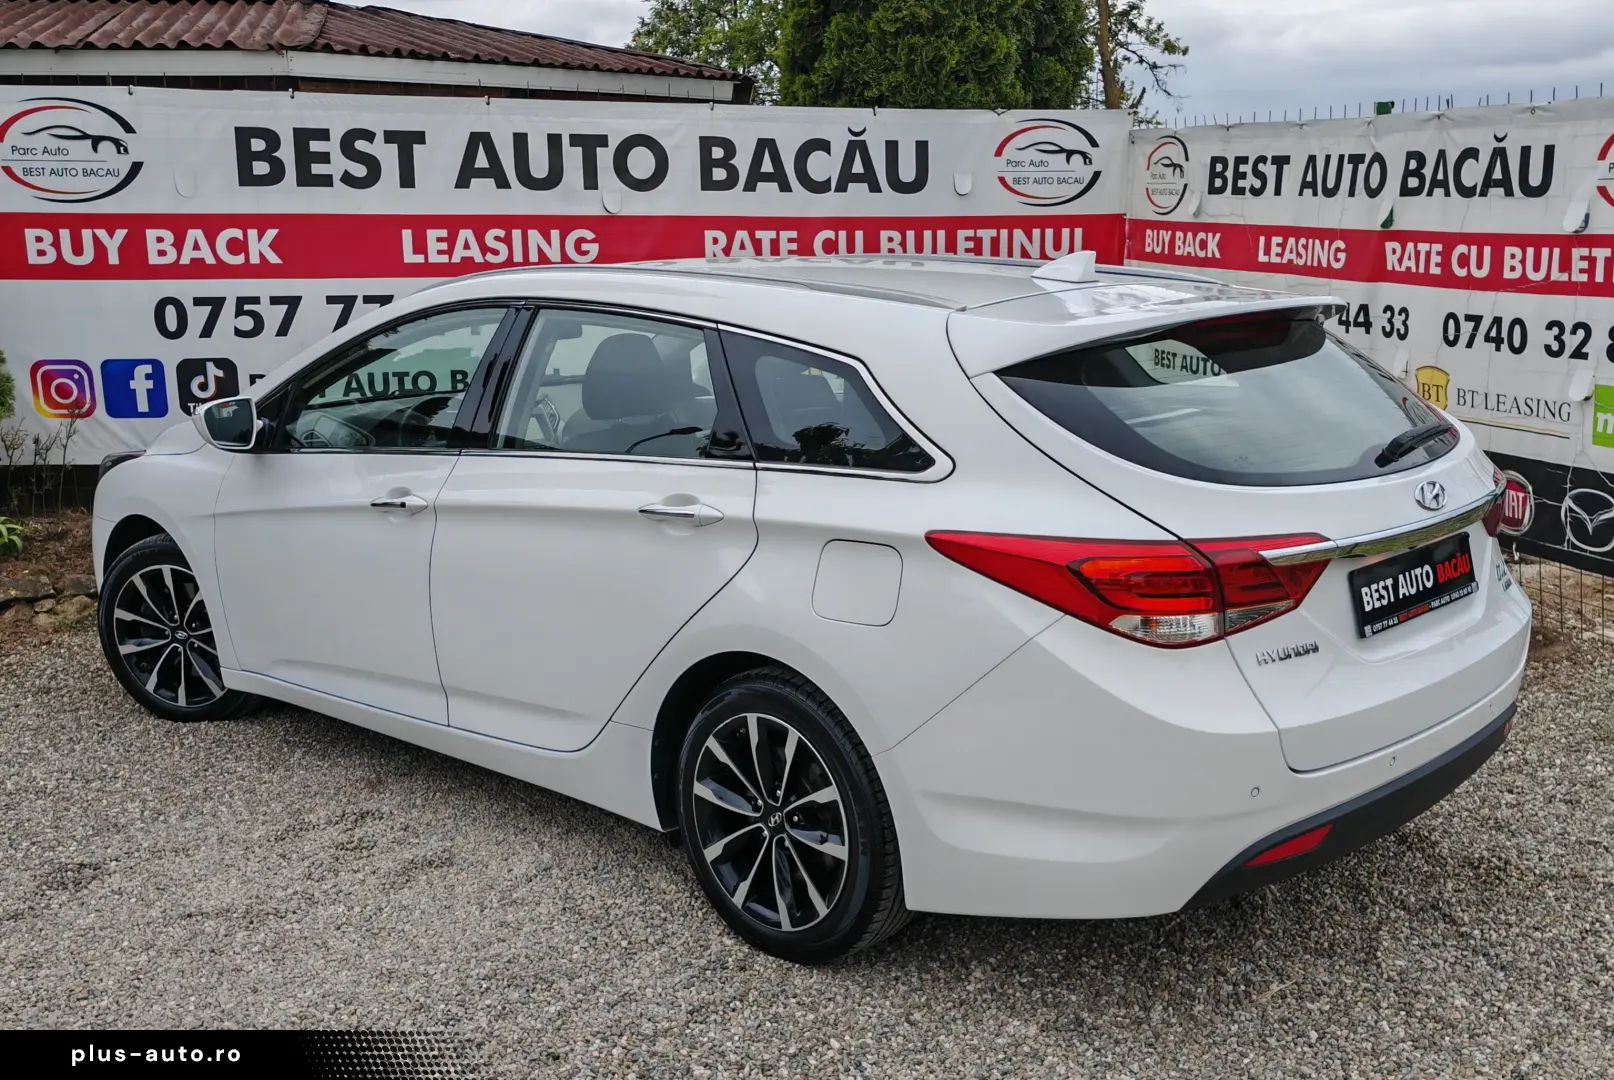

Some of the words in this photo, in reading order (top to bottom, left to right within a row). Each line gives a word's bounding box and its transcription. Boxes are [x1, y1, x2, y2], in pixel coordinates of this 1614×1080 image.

[11, 145, 38, 156] Parc
[42, 146, 70, 156] Auto
[234, 126, 426, 190] BEST
[454, 131, 669, 192] AUTO
[698, 126, 929, 194] BACĂU
[1006, 159, 1026, 168] Parc
[1029, 159, 1049, 168] Auto
[1207, 155, 1290, 197] BEST
[1298, 151, 1388, 199] AUTO
[1400, 131, 1555, 198] BACĂU
[22, 167, 46, 177] BEST
[49, 167, 78, 178] AUTO
[82, 167, 120, 178] BACAU
[1012, 176, 1031, 186] BEST
[1032, 176, 1055, 185] AUTO
[24, 228, 128, 266] BUY
[145, 228, 283, 266] BACK
[401, 228, 600, 264] LEASING
[704, 229, 799, 258] RATE
[813, 229, 864, 257] CU
[879, 227, 1083, 259] BULETINUL
[1145, 228, 1172, 254] BUY
[1174, 231, 1222, 259] BACK
[1258, 235, 1347, 270] LEASING
[1384, 241, 1443, 275] RATE
[1451, 244, 1492, 279] CU
[1503, 246, 1614, 284] BULET
[154, 295, 303, 340] 0757
[1338, 302, 1373, 335] 44
[1382, 304, 1410, 341] 33
[1442, 311, 1528, 355] 0740
[1544, 319, 1592, 361] 32
[1154, 348, 1177, 371] BEST
[1180, 354, 1222, 377] AUTO
[343, 370, 437, 398] AUTO
[1421, 382, 1444, 403] BT
[1456, 388, 1479, 409] BT
[1484, 392, 1571, 423] LEASING
[1503, 489, 1525, 520] IAT
[1361, 577, 1394, 612] BEST
[1398, 564, 1434, 599] AUTO
[1436, 552, 1471, 584] BACĂU
[1256, 640, 1320, 667] HYUNDAI
